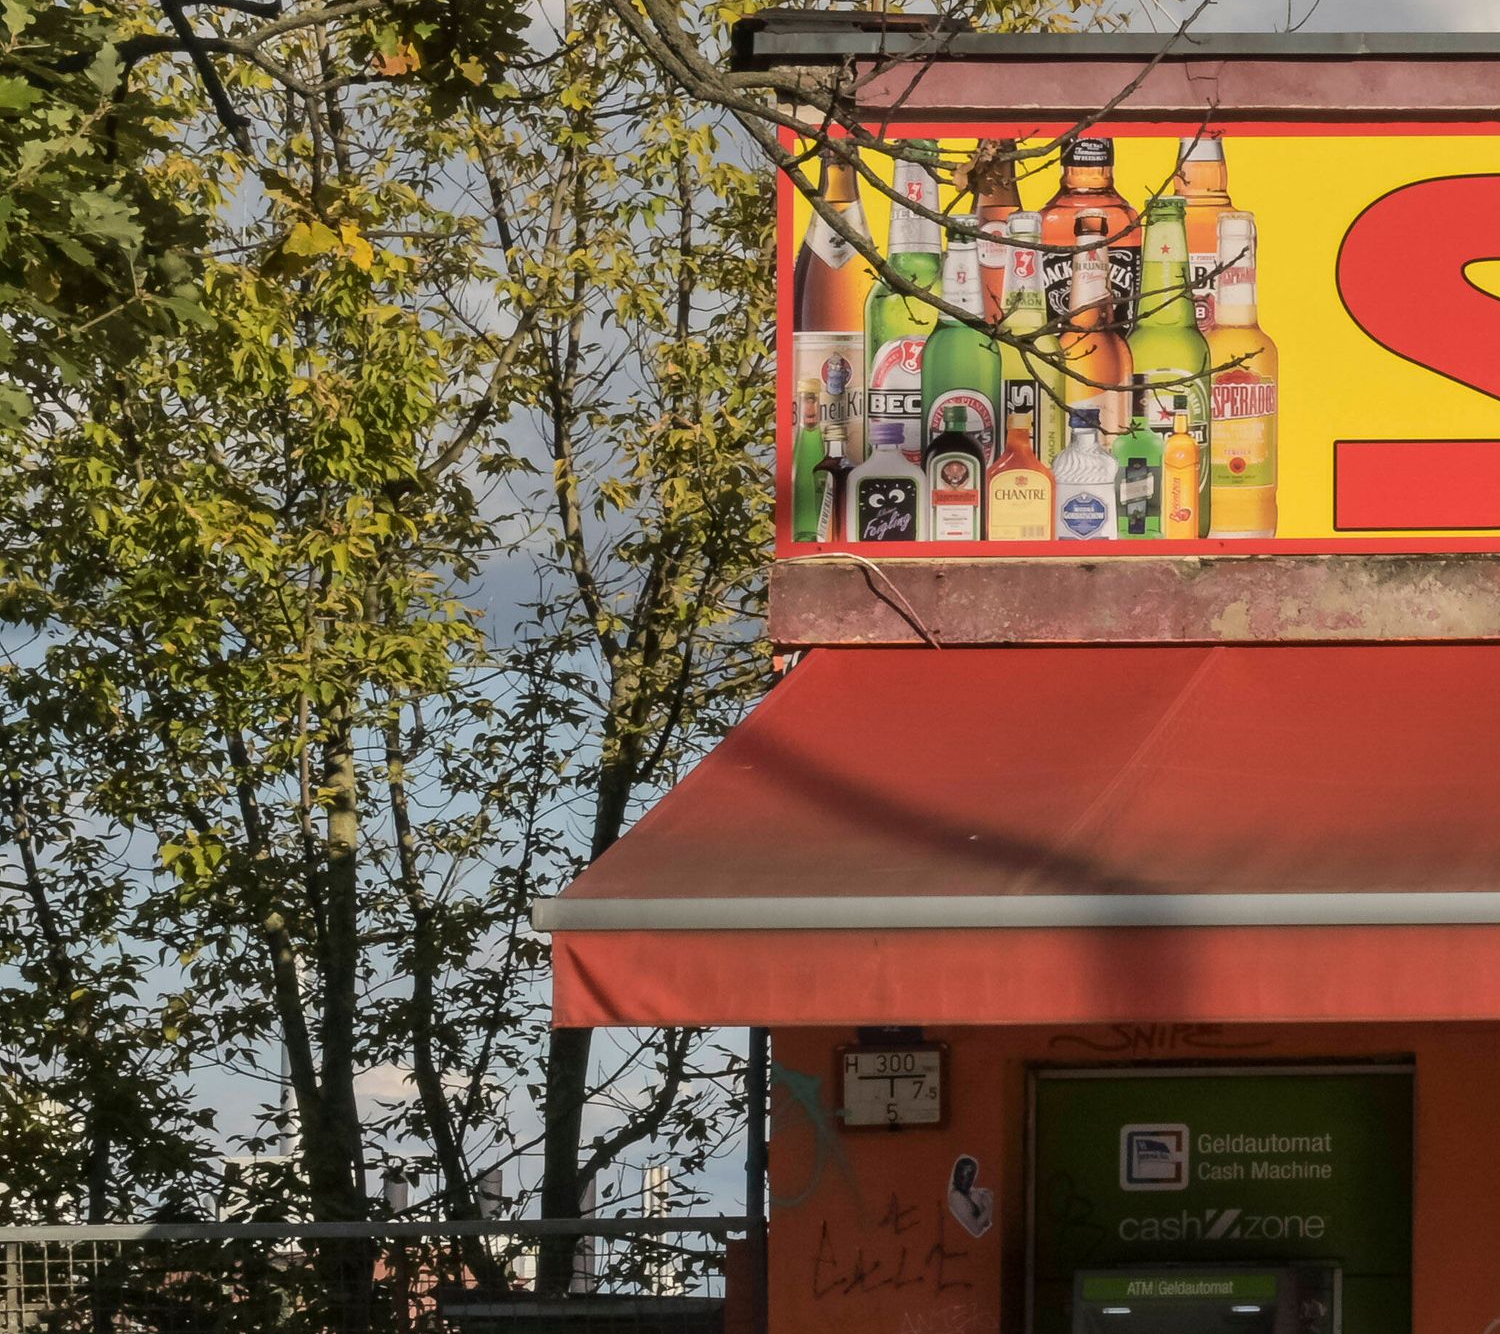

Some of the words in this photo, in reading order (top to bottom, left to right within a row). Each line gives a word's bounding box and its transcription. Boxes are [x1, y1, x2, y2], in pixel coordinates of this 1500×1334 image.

[871, 394, 921, 413] BEC
[864, 511, 913, 541] Feigling
[845, 1056, 859, 1074] H
[876, 1053, 916, 1073] 300
[1198, 1134, 1332, 1154] Geldautomat
[1198, 1161, 1246, 1181] Cash
[1251, 1161, 1332, 1181] Machine
[1127, 1280, 1154, 1296] ATM
[1158, 1279, 1233, 1296] Geldautomat
